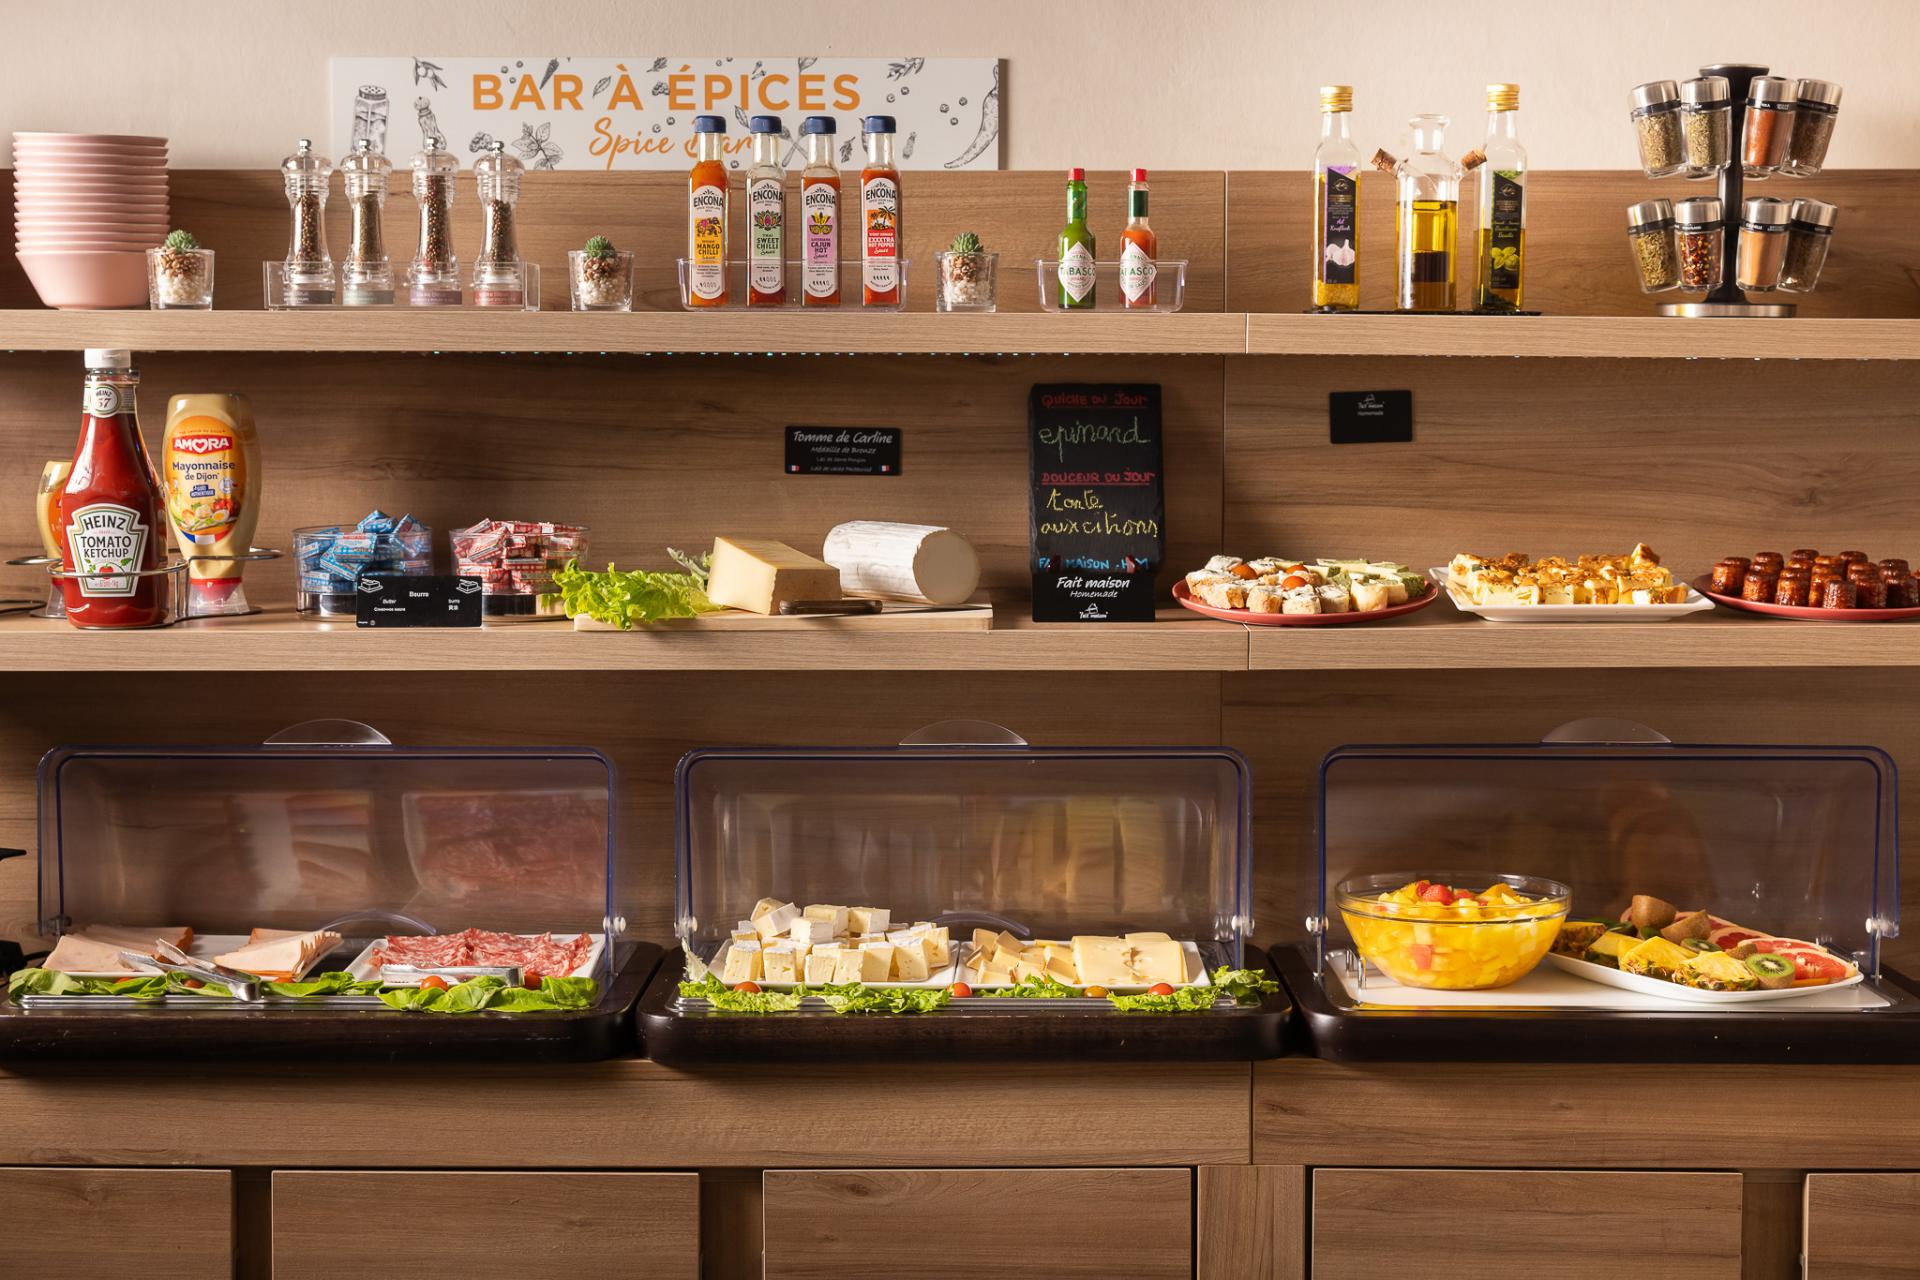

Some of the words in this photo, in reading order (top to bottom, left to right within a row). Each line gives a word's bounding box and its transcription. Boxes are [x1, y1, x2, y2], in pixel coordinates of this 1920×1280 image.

[473, 74, 584, 111] BAR
[607, 64, 644, 111] À
[668, 64, 861, 111] ÉPICES
[588, 117, 675, 170] Spice
[753, 190, 783, 202] ENCONA
[806, 194, 836, 206] ENCONA
[866, 188, 896, 200] ENCONA
[693, 196, 724, 208] ENCONA
[793, 431, 834, 443] Tomme
[835, 430, 851, 443] de
[852, 431, 893, 444] Carline
[173, 437, 230, 454] AMORA
[172, 460, 236, 473] Mayonnaise
[184, 473, 195, 481] de
[1041, 472, 1100, 482] DOUCEUR
[83, 514, 127, 530] HEINZ
[80, 536, 132, 548] TOMATO
[84, 549, 129, 558] KETCHUP
[1056, 576, 1083, 589] Fait
[1085, 576, 1130, 589] maison
[1070, 590, 1119, 598] Homemade
